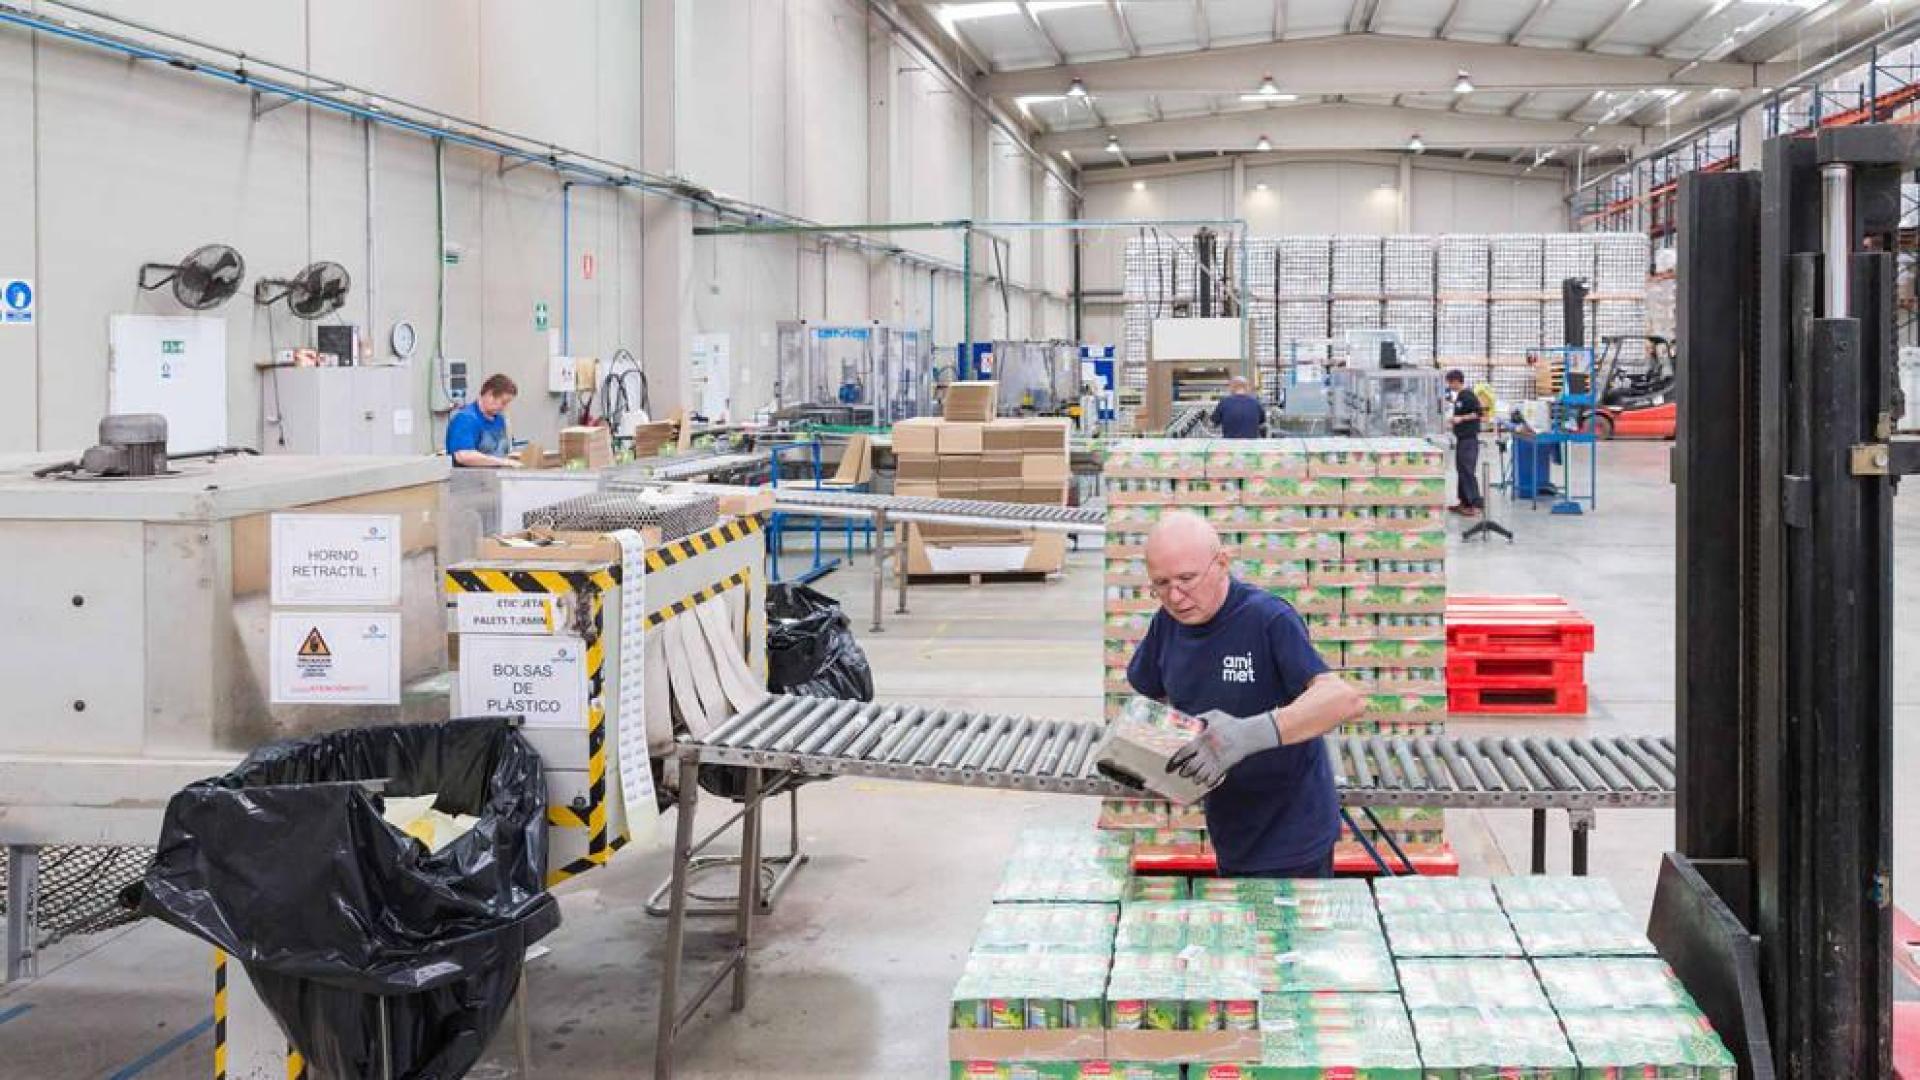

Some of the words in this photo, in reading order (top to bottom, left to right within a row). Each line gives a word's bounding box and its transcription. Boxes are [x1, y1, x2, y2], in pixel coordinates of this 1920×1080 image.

[308, 549, 359, 561] HORNO
[292, 565, 368, 577] RETRACTIL
[371, 566, 378, 577] 1
[472, 616, 507, 625] PALETS
[1223, 651, 1252, 669] ami
[492, 663, 552, 678] BOLSAS
[1223, 668, 1256, 683] met
[513, 681, 534, 695] DE
[486, 696, 561, 713] PLÁSTICO
